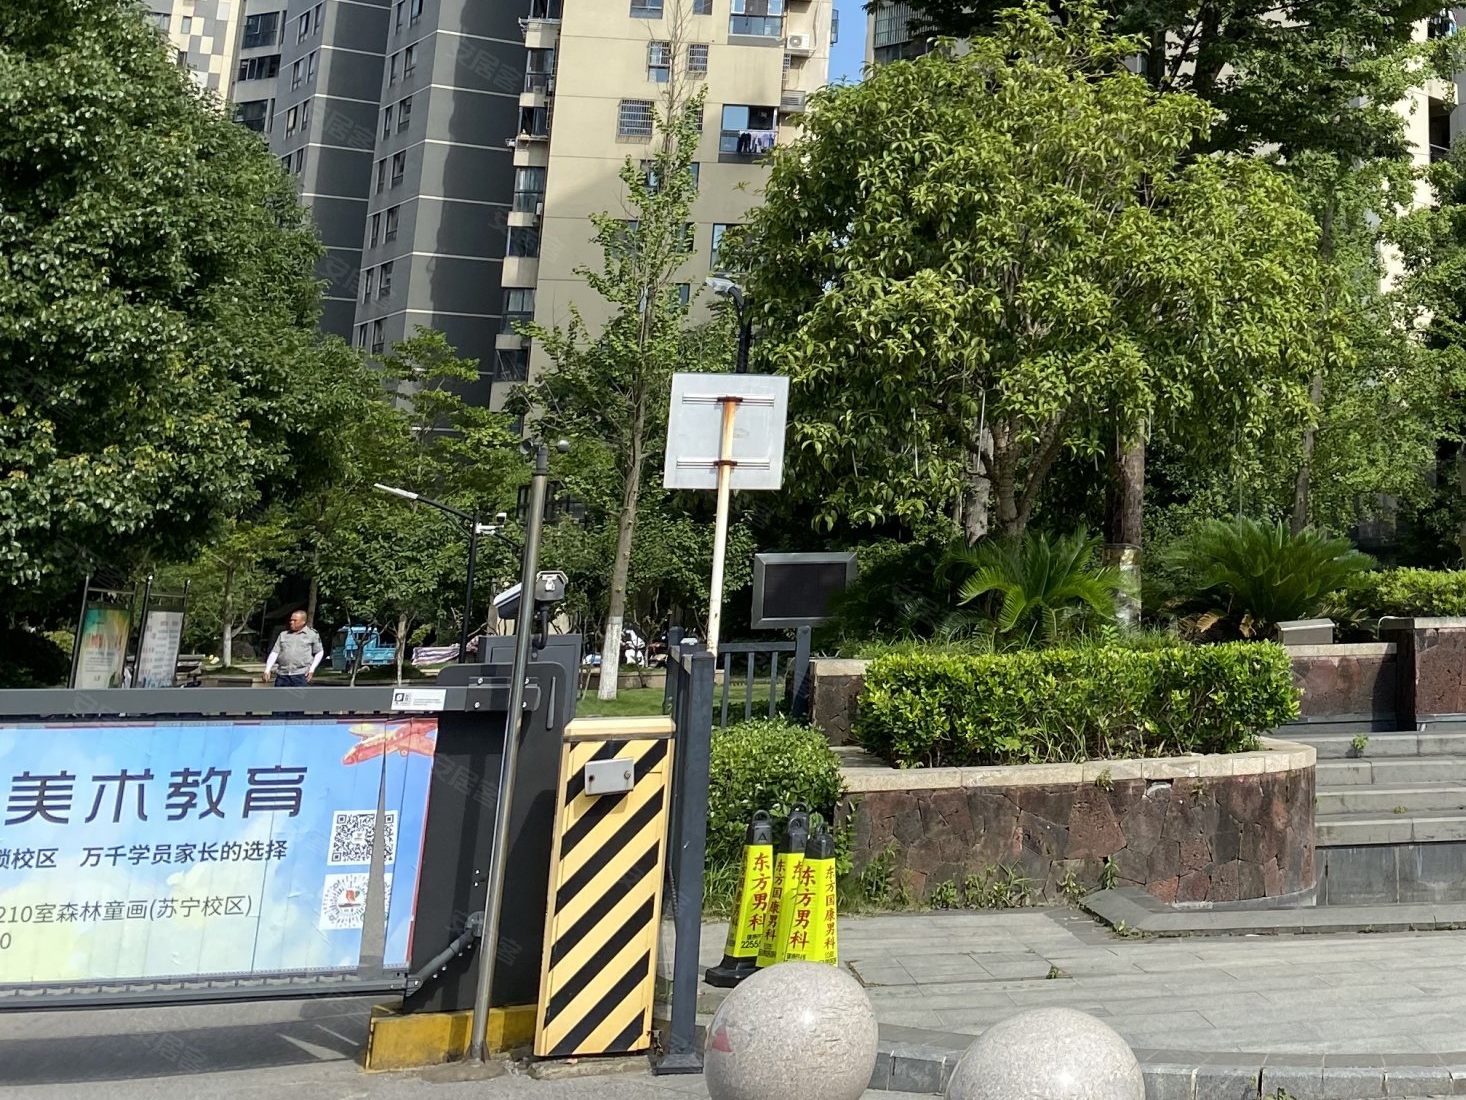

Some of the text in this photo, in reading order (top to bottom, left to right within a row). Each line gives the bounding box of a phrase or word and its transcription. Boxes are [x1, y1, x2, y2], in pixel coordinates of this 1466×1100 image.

[5, 765, 307, 826] 美术教育
[80, 840, 288, 867] 万千学员家长的选择
[748, 852, 771, 931] 东方男科
[789, 866, 816, 950] 东方男科
